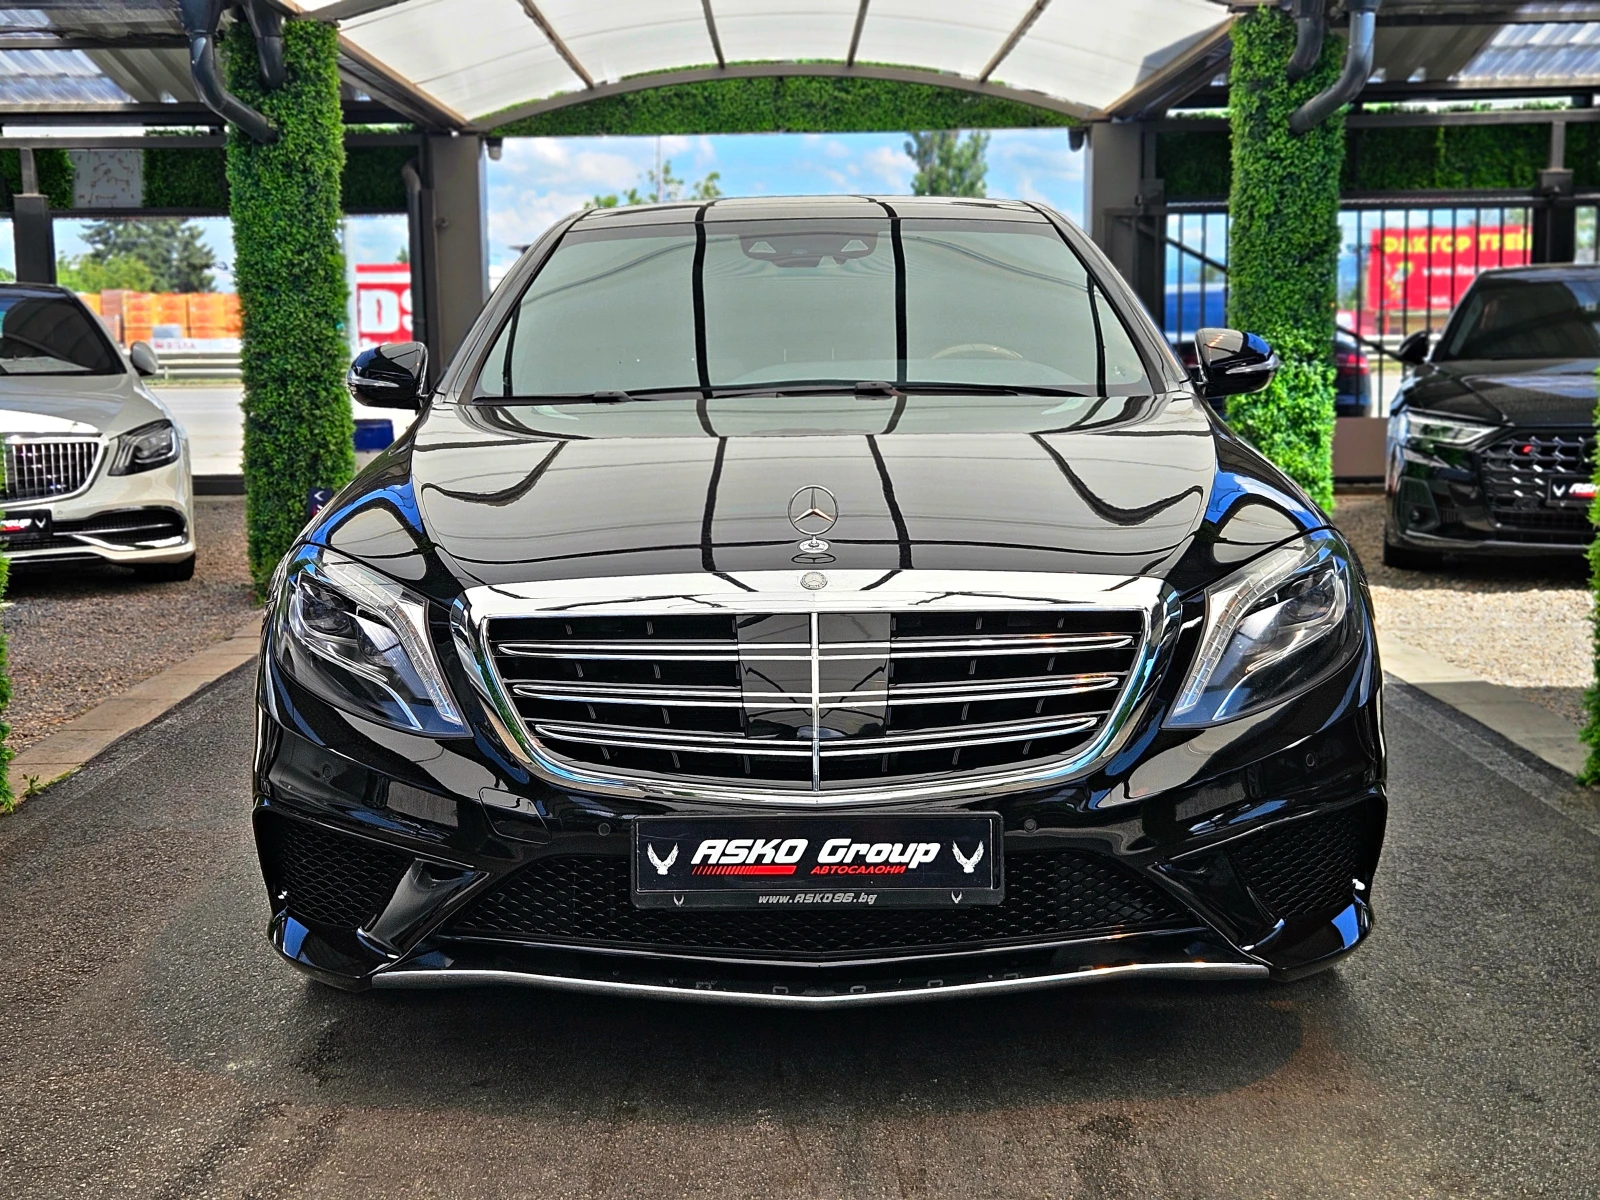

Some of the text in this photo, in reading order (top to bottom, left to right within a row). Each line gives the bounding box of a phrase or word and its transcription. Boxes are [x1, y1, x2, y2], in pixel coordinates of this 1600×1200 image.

[691, 838, 941, 869] ASKO Group
[810, 865, 907, 875] АВТОСАЛОНИ
[758, 893, 878, 905] www.ASKO96.bg
